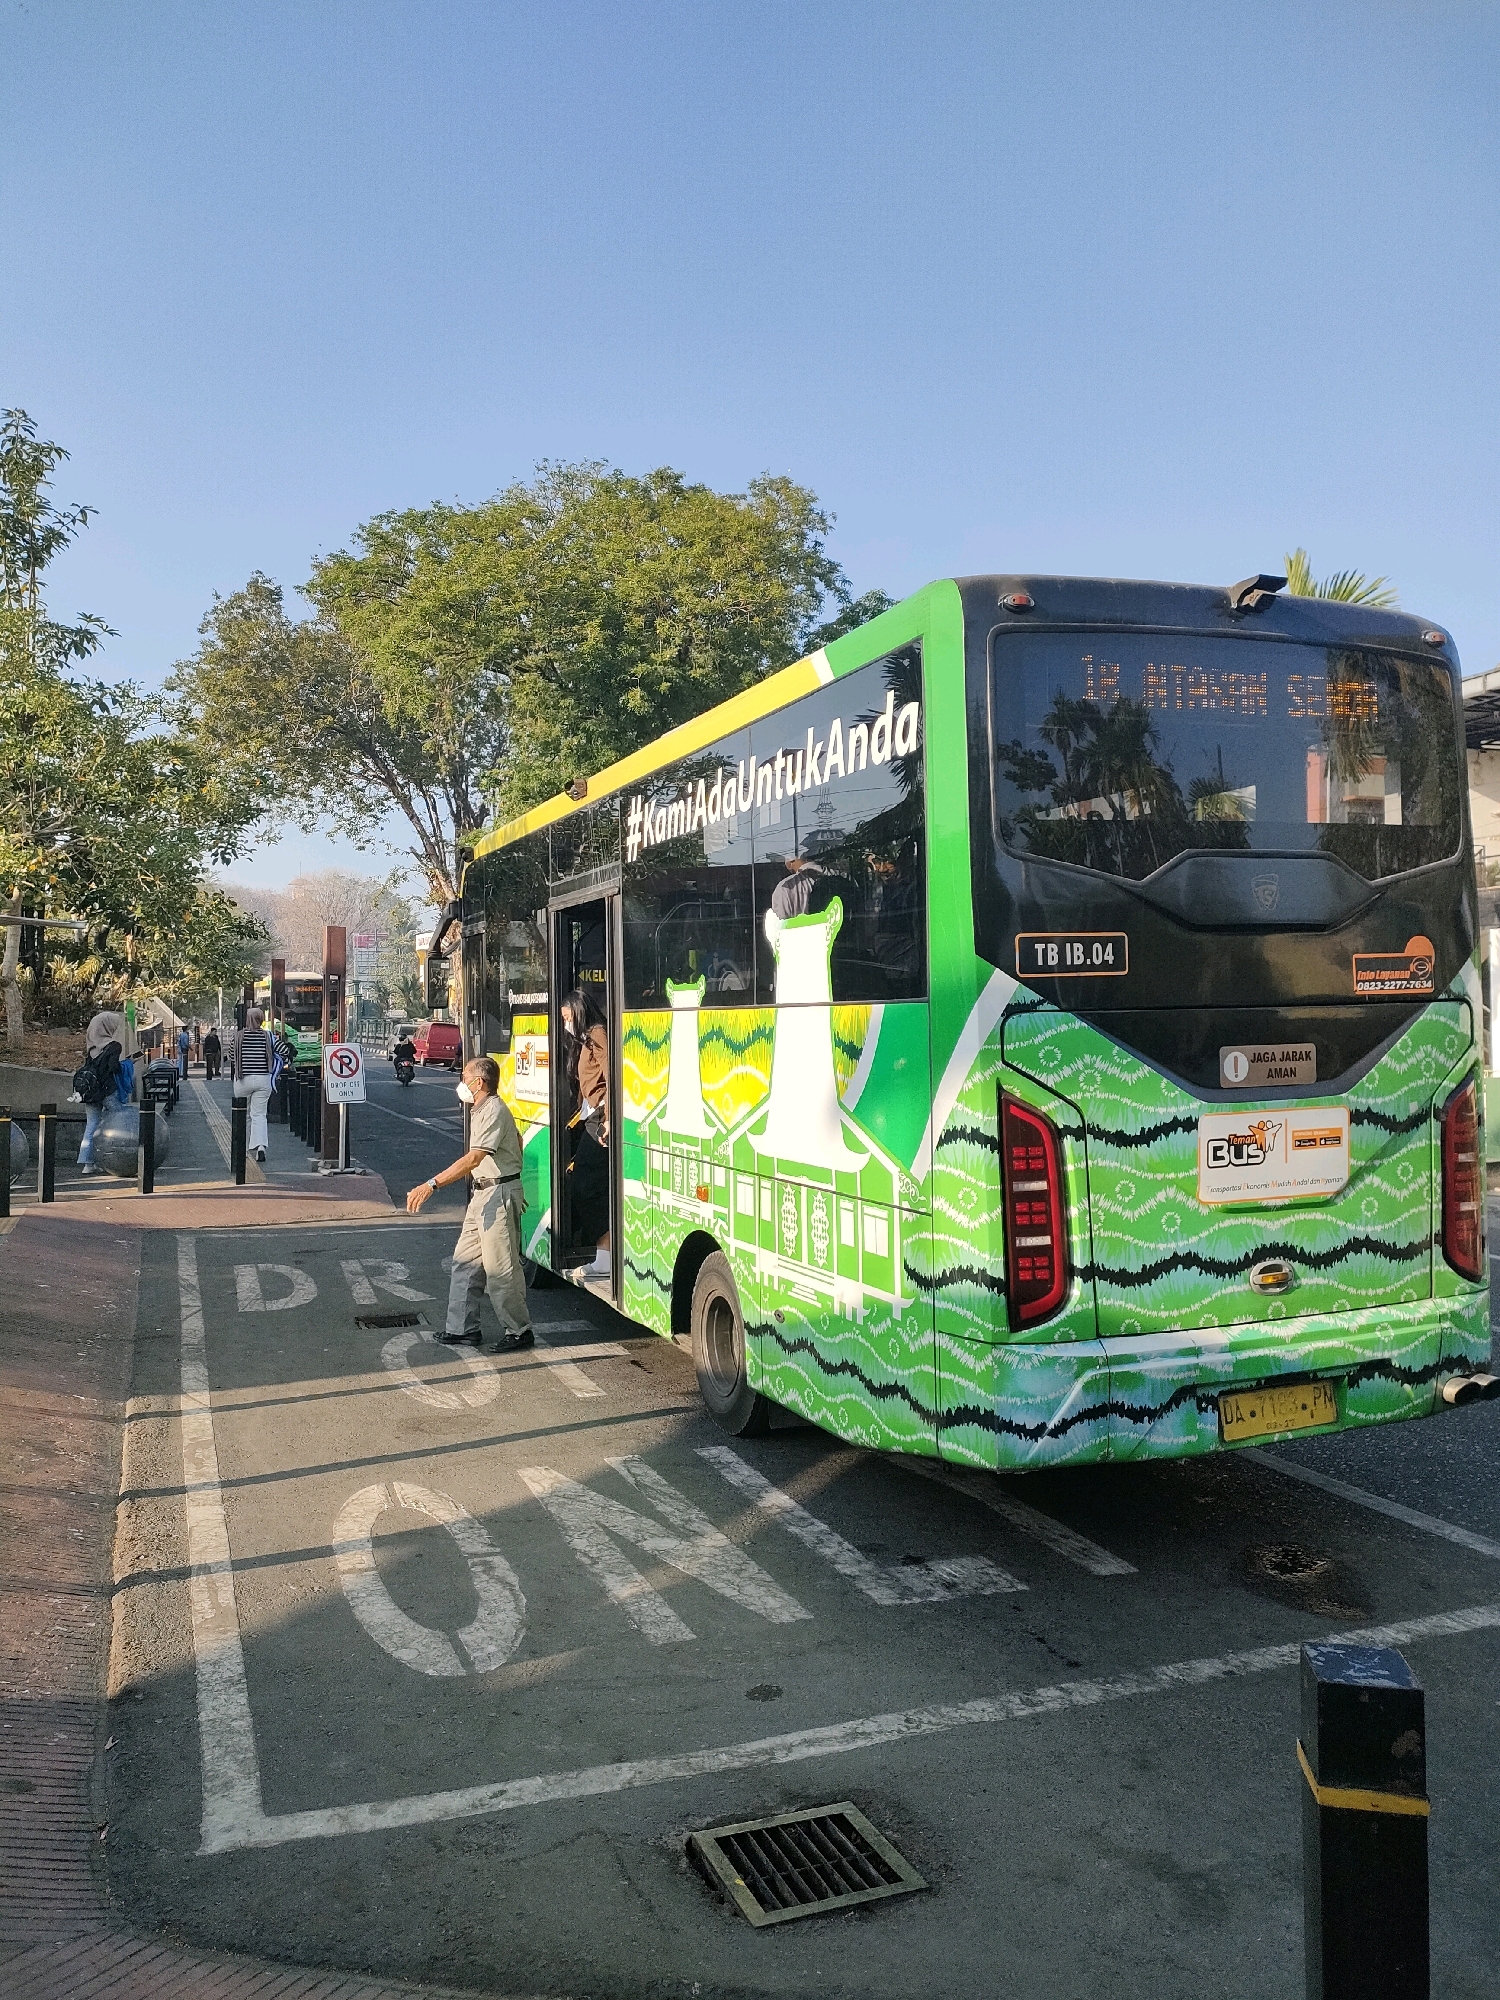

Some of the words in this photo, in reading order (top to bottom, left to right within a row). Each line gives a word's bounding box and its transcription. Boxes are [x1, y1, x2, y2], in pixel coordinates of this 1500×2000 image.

[626, 689, 920, 864] #KamiAdaUntukAnda
[1034, 943, 1059, 966] TB
[585, 969, 607, 983] KEL
[1375, 970, 1411, 980] Layanan
[1357, 980, 1432, 991] 0823-2277-7634
[1250, 1051, 1277, 1064] JAGA
[1279, 1050, 1312, 1062] JARAK
[1266, 1067, 1297, 1079] AMAN
[1229, 1134, 1257, 1145] Teman
[234, 1258, 452, 1312] DR
[1222, 1399, 1246, 1425] DA
